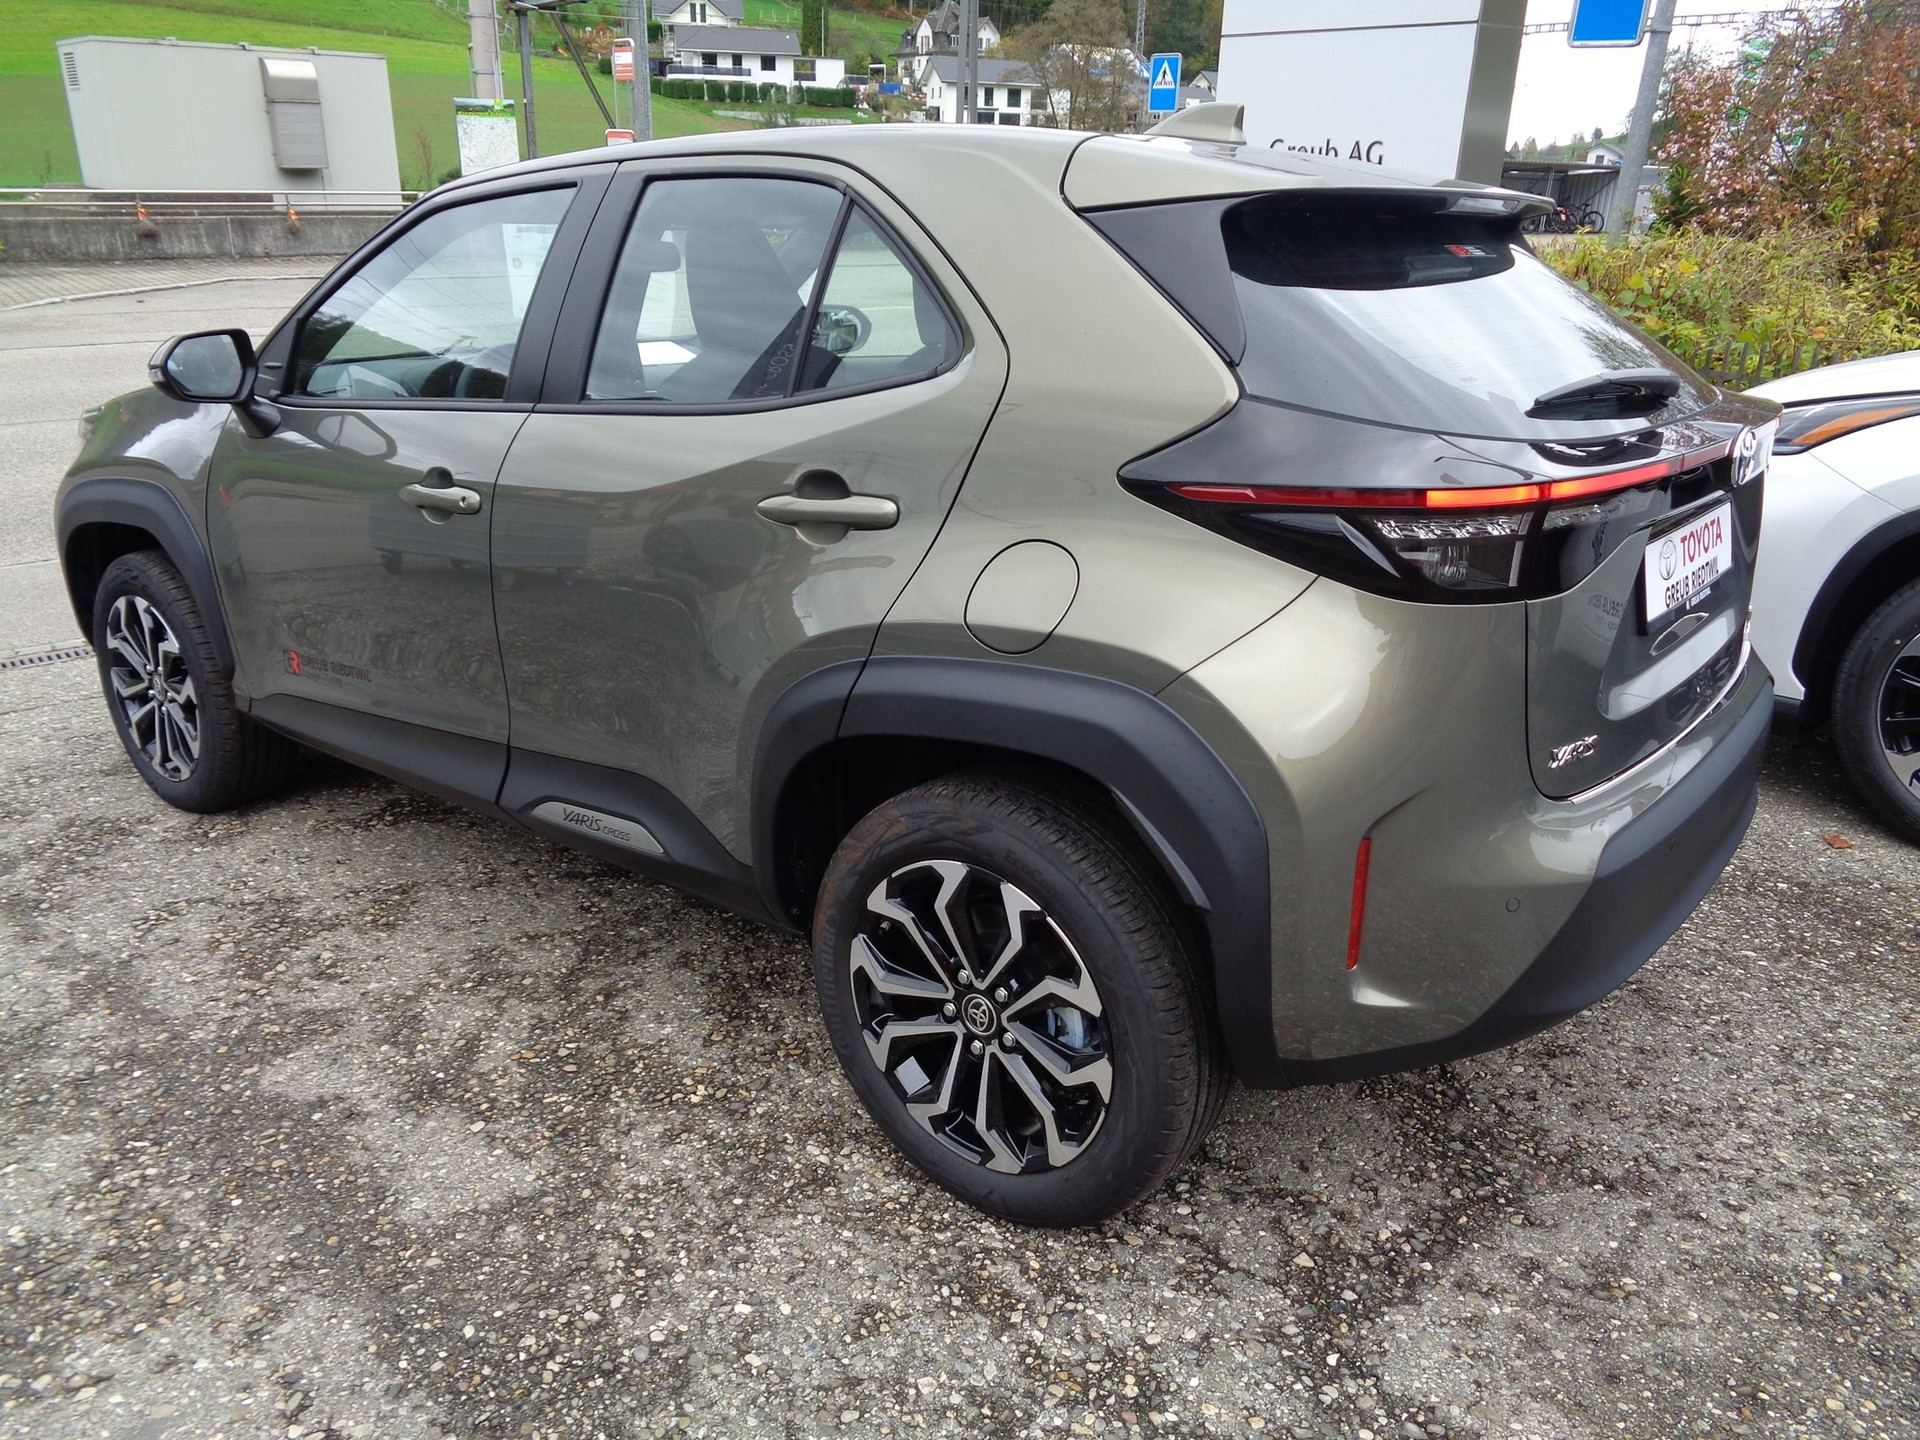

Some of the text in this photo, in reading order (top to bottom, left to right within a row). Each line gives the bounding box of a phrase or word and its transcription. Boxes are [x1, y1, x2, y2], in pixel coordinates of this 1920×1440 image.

[1348, 139, 1384, 166] AG
[1680, 516, 1723, 567] TOYOTA
[1664, 575, 1690, 609] GREUB
[1691, 555, 1719, 590] RIEDTWIL
[602, 826, 631, 842] CROSS
